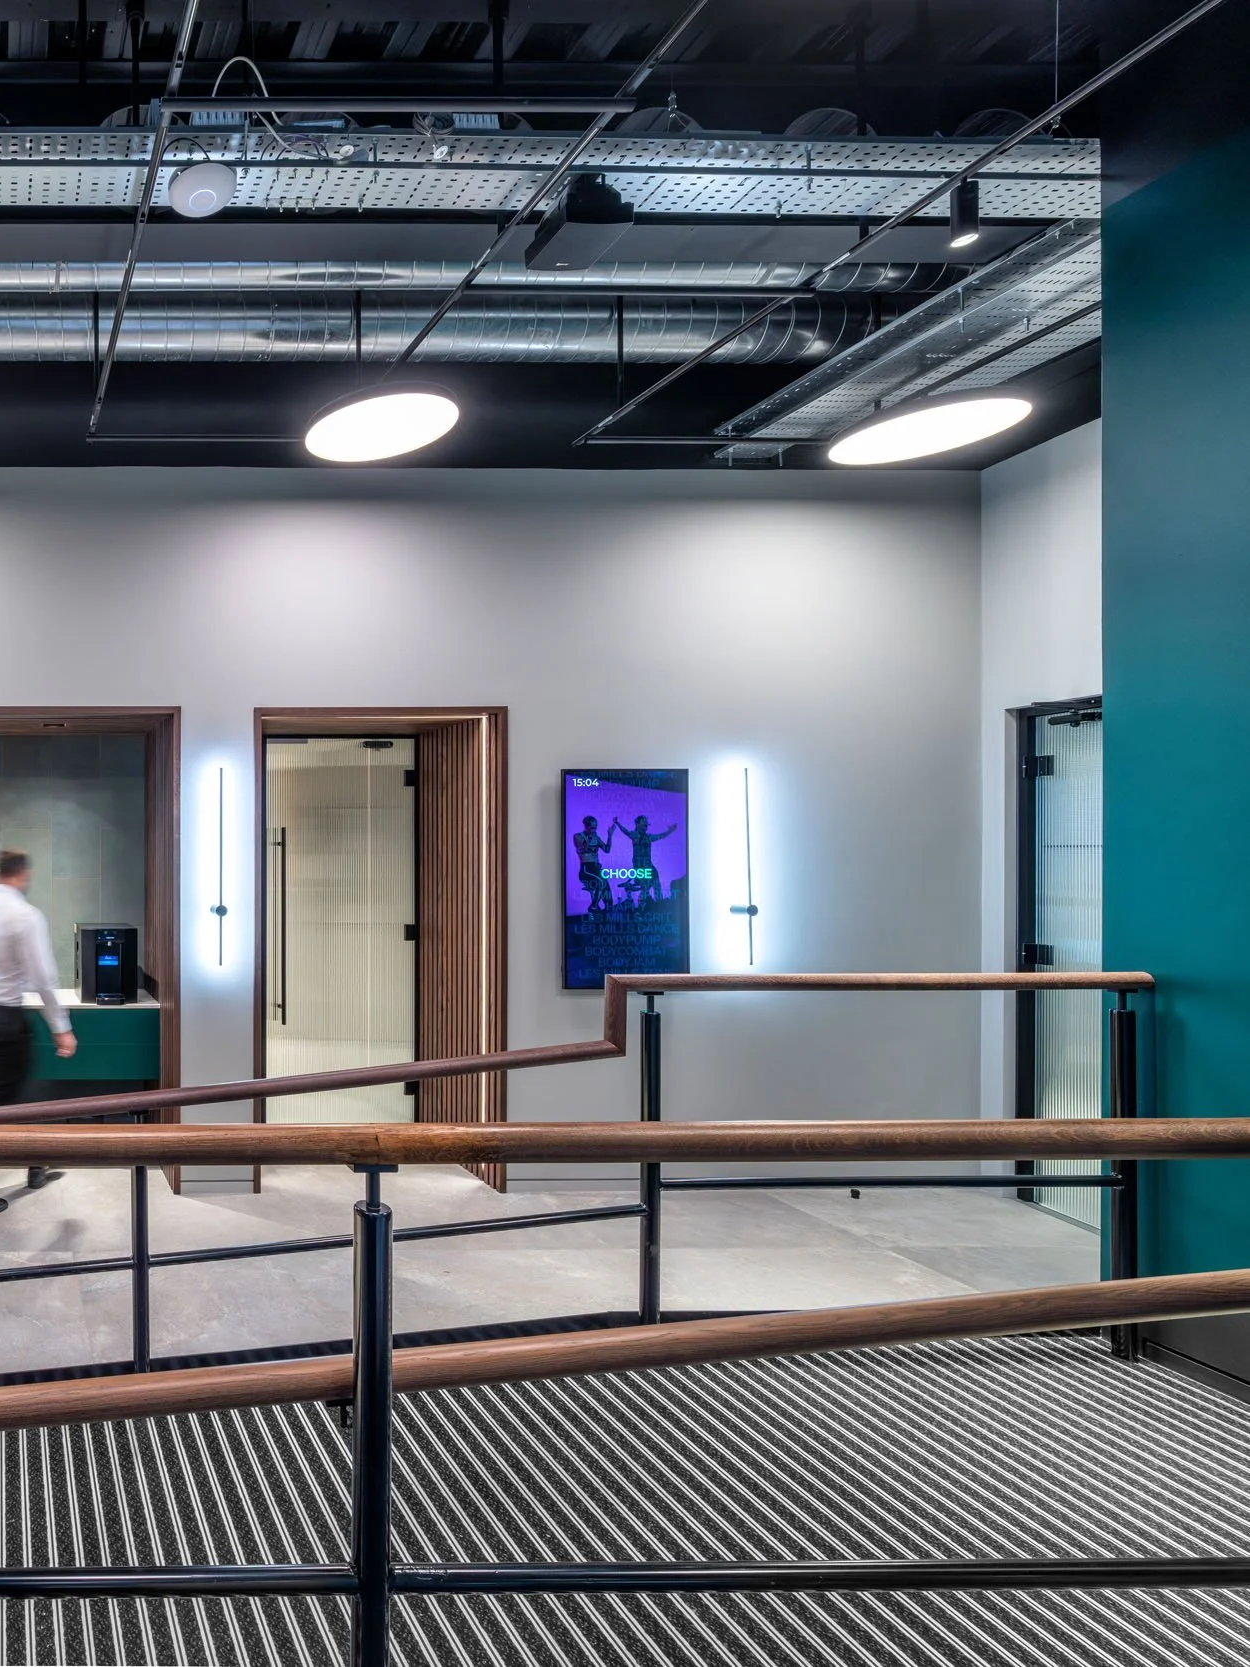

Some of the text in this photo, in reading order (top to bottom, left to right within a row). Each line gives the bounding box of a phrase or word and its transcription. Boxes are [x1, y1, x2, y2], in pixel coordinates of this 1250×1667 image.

[572, 778, 600, 787] 15:04
[600, 868, 653, 879] CHOOSE
[606, 912, 642, 923] MILLS
[574, 923, 679, 934] LES MILLS DANCE
[592, 935, 661, 946] BODYPUMP
[585, 946, 667, 957] BODYCOMBAT
[598, 957, 656, 967] BODYJAM
